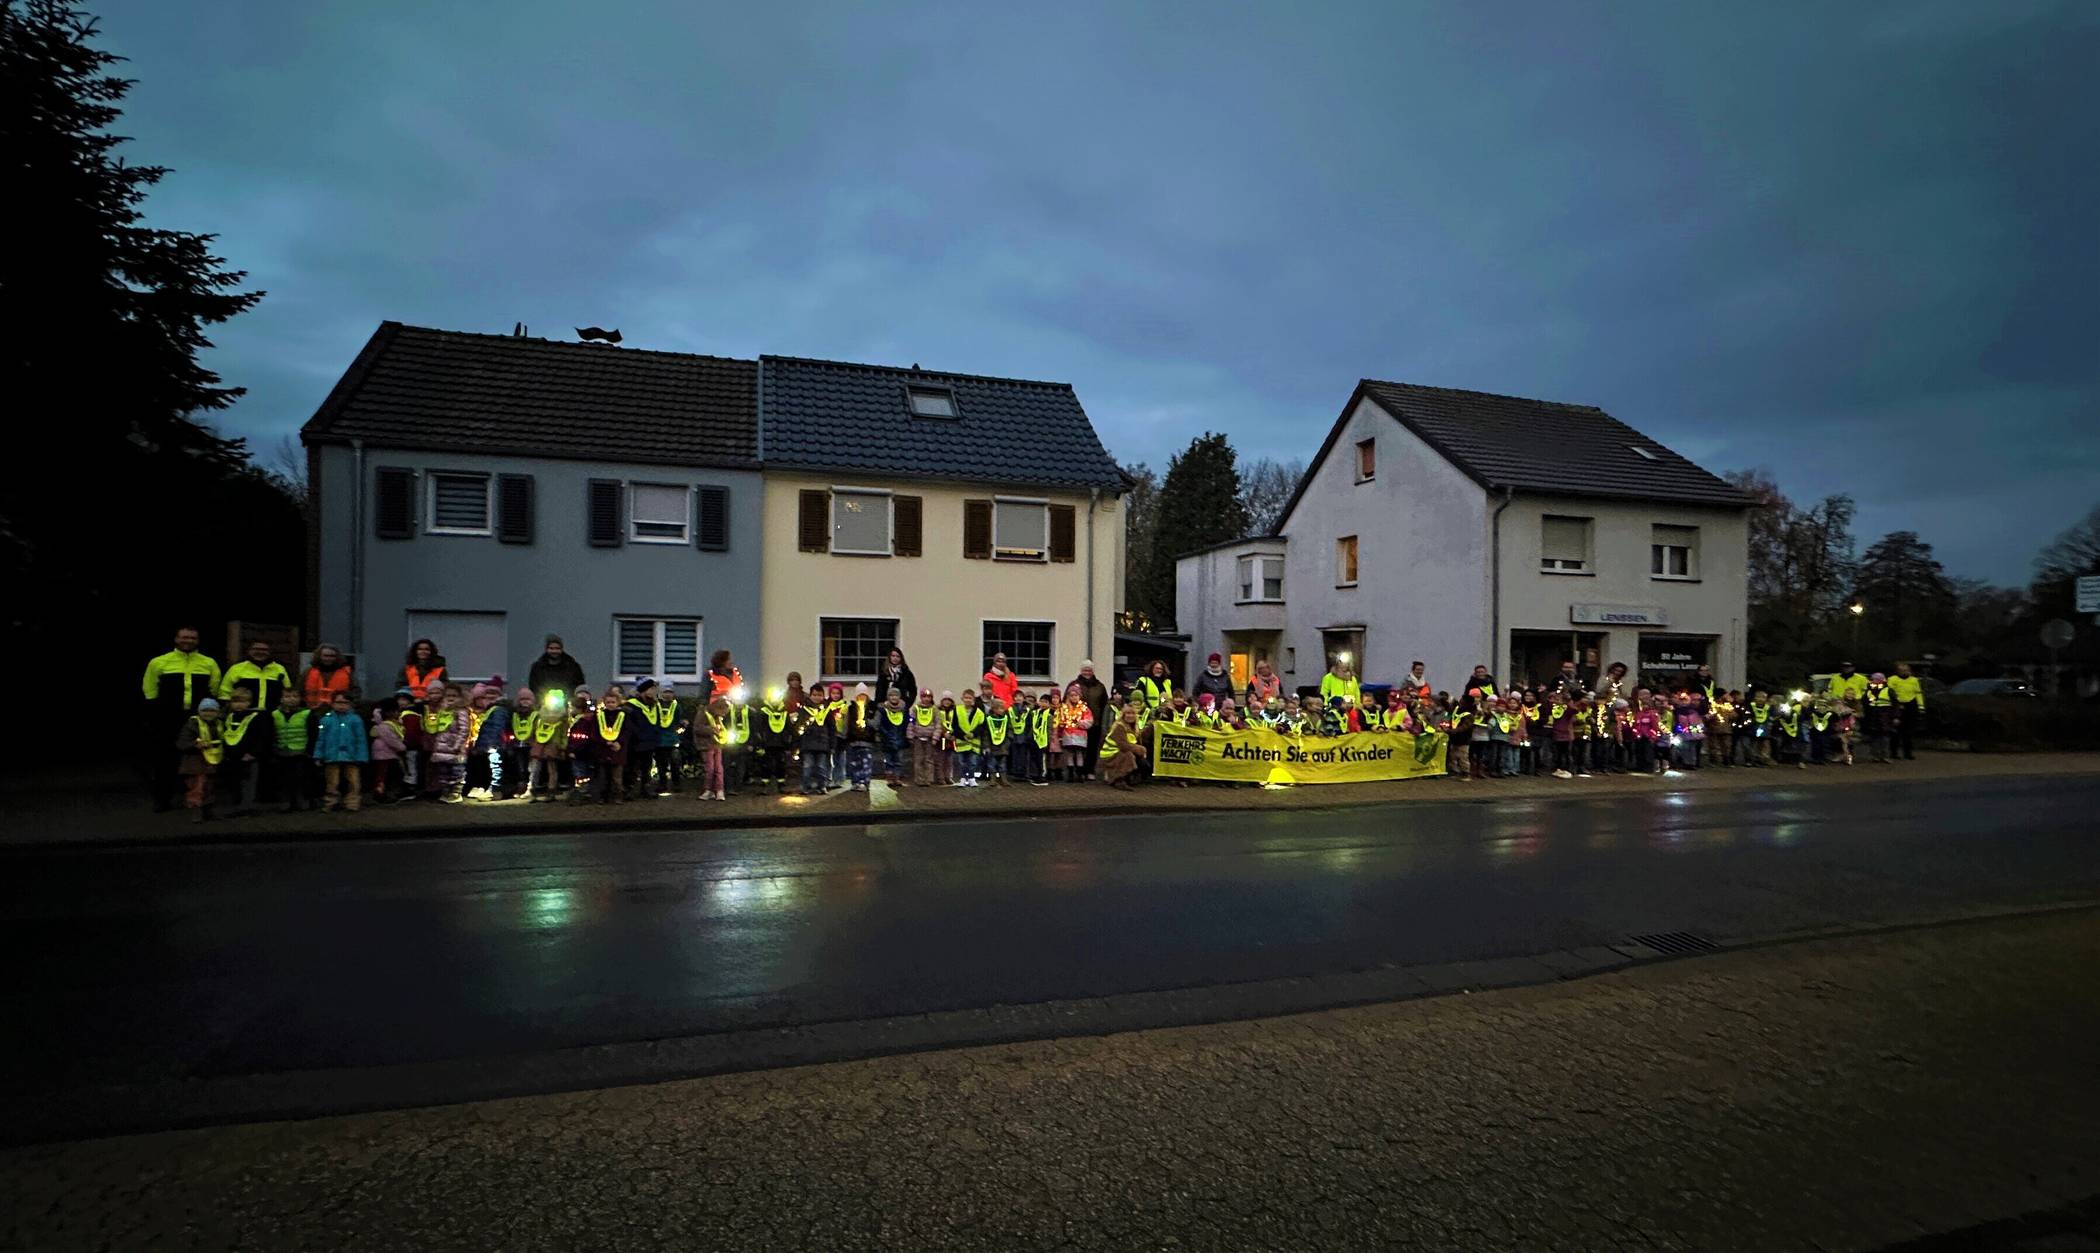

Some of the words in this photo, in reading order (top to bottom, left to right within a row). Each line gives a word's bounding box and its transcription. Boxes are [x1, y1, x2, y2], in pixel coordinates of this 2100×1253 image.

[1161, 736, 1206, 751] VERKEHRS
[1160, 749, 1192, 760] WACHT
[1222, 741, 1281, 761] Achten
[1286, 745, 1308, 763] Sie
[1311, 746, 1336, 763] auf
[1339, 743, 1394, 762] Kinder
